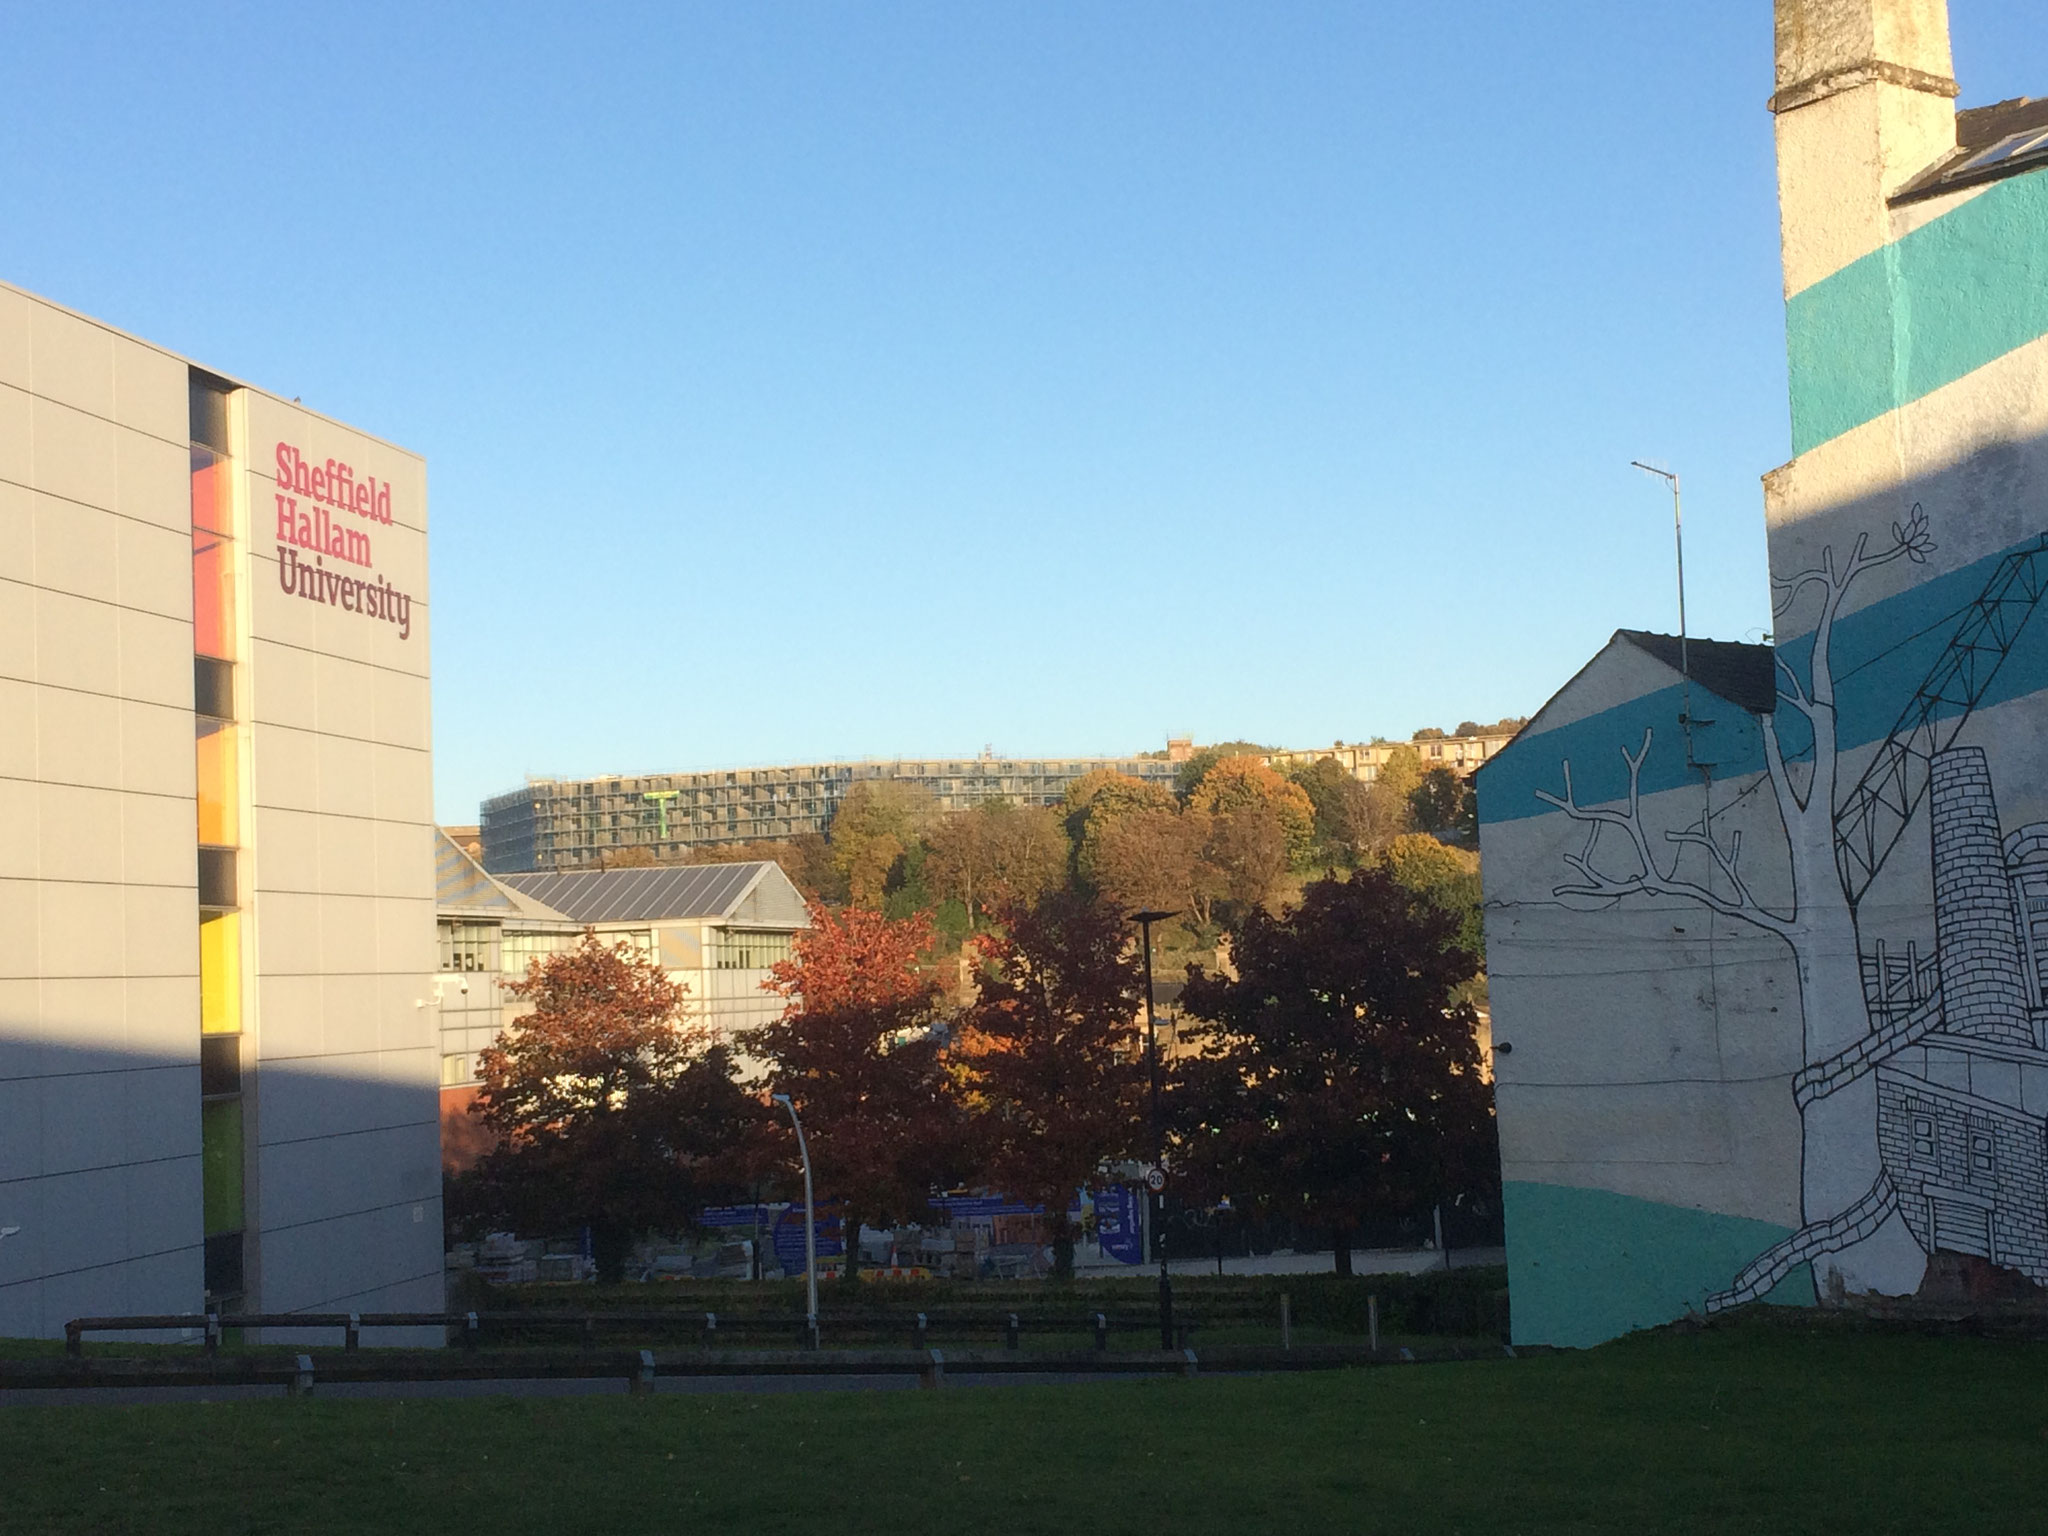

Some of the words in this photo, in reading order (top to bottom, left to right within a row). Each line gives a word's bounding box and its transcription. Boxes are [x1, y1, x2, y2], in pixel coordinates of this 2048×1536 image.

[276, 442, 393, 526] Sheffield
[275, 493, 373, 568] Hallam
[277, 545, 411, 640] University
[1150, 1175, 1163, 1185] 20
